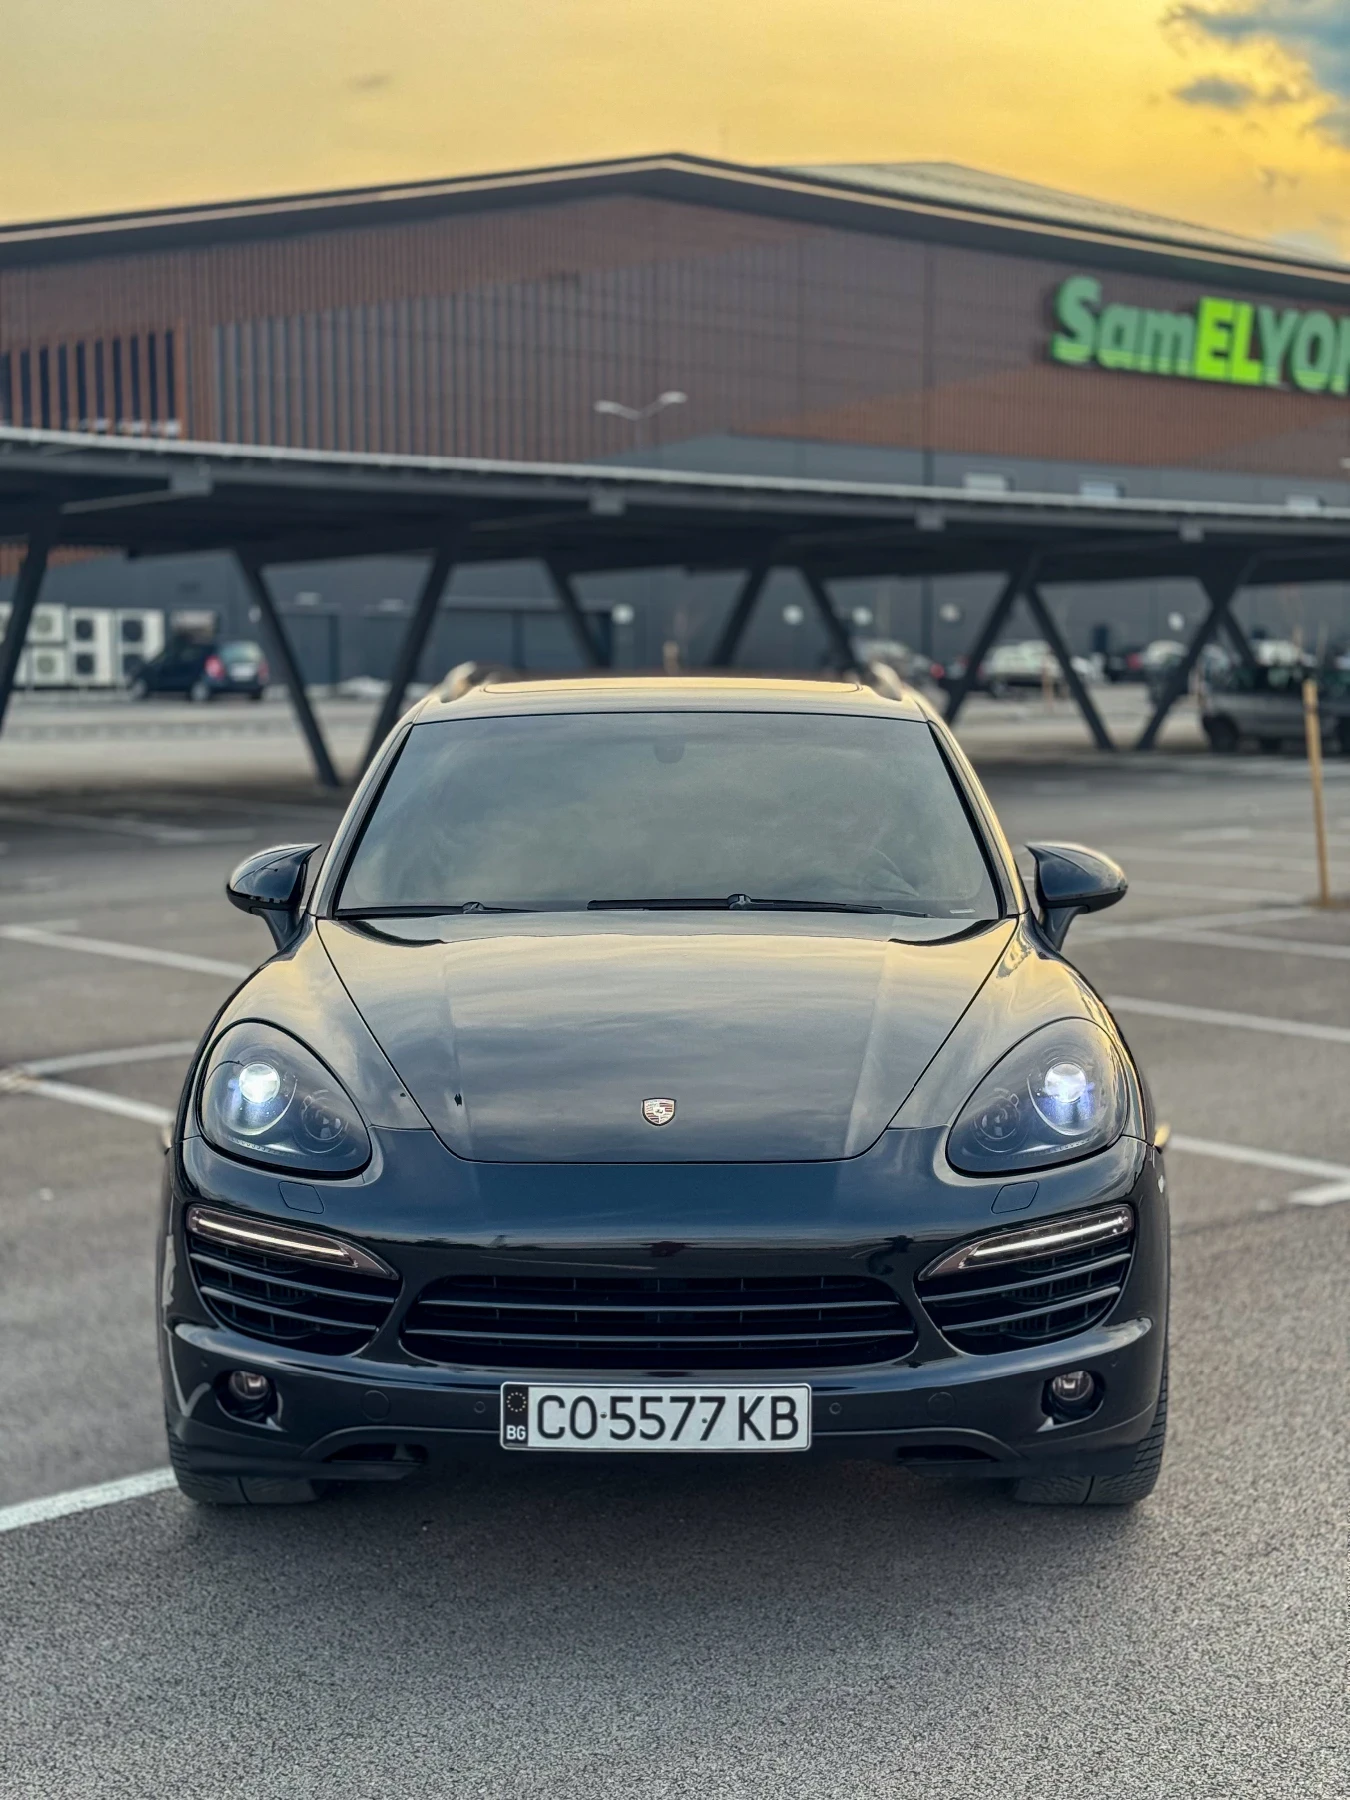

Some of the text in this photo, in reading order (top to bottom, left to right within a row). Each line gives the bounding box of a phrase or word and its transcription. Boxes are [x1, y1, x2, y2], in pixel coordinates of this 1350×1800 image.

[506, 1424, 526, 1440] BG
[609, 1395, 726, 1441] 5577
[737, 1395, 799, 1441] KB
